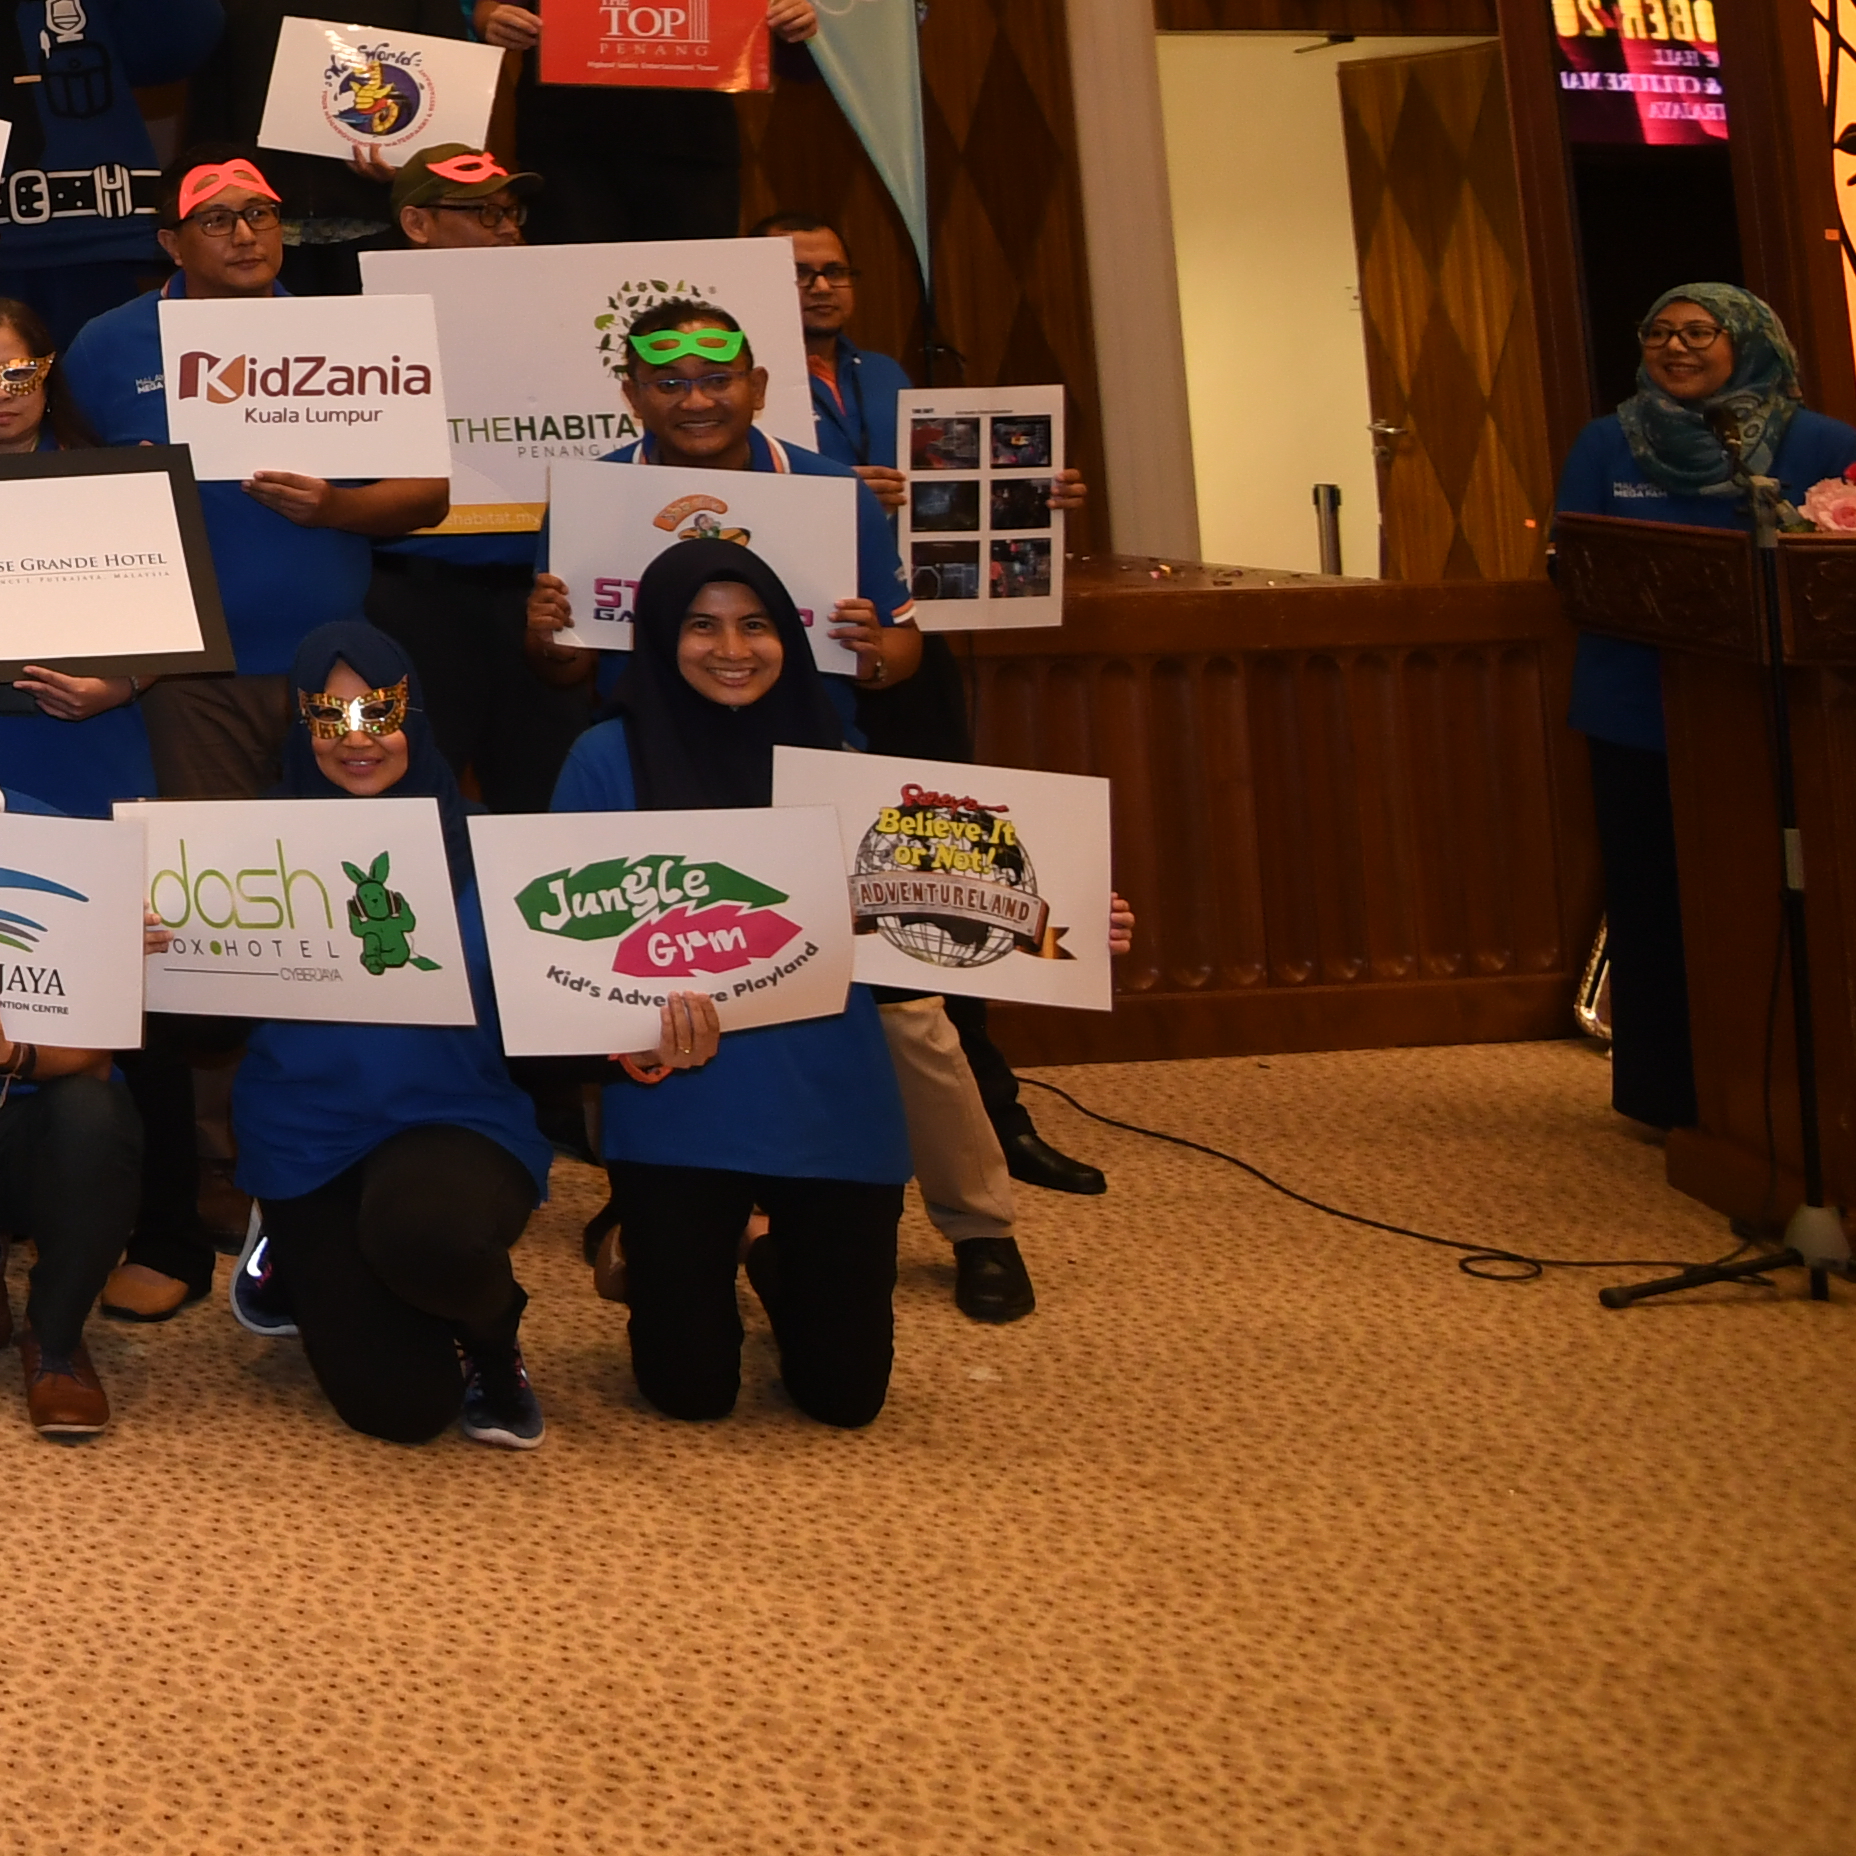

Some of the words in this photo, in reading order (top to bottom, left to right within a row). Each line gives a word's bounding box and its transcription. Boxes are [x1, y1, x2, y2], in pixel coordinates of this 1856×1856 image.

[599, 7, 686, 37] TOP
[599, 42, 708, 57] PENANG
[178, 350, 433, 405] KidZania
[244, 406, 301, 425] Kuala
[305, 406, 384, 428] Lumpur
[517, 444, 601, 458] PENANG
[20, 555, 99, 571] GRANDE
[104, 552, 168, 567] HOTEL
[875, 806, 984, 844] Believe
[987, 819, 1017, 846] It
[894, 844, 929, 866] or
[933, 844, 996, 875] Not!
[858, 880, 1031, 924] ADVENTURELAND
[280, 967, 344, 983] CYBERJAYA
[545, 965, 602, 1000] Kid's
[733, 940, 820, 1000] Playland
[32, 1003, 69, 1015] CENTRE
